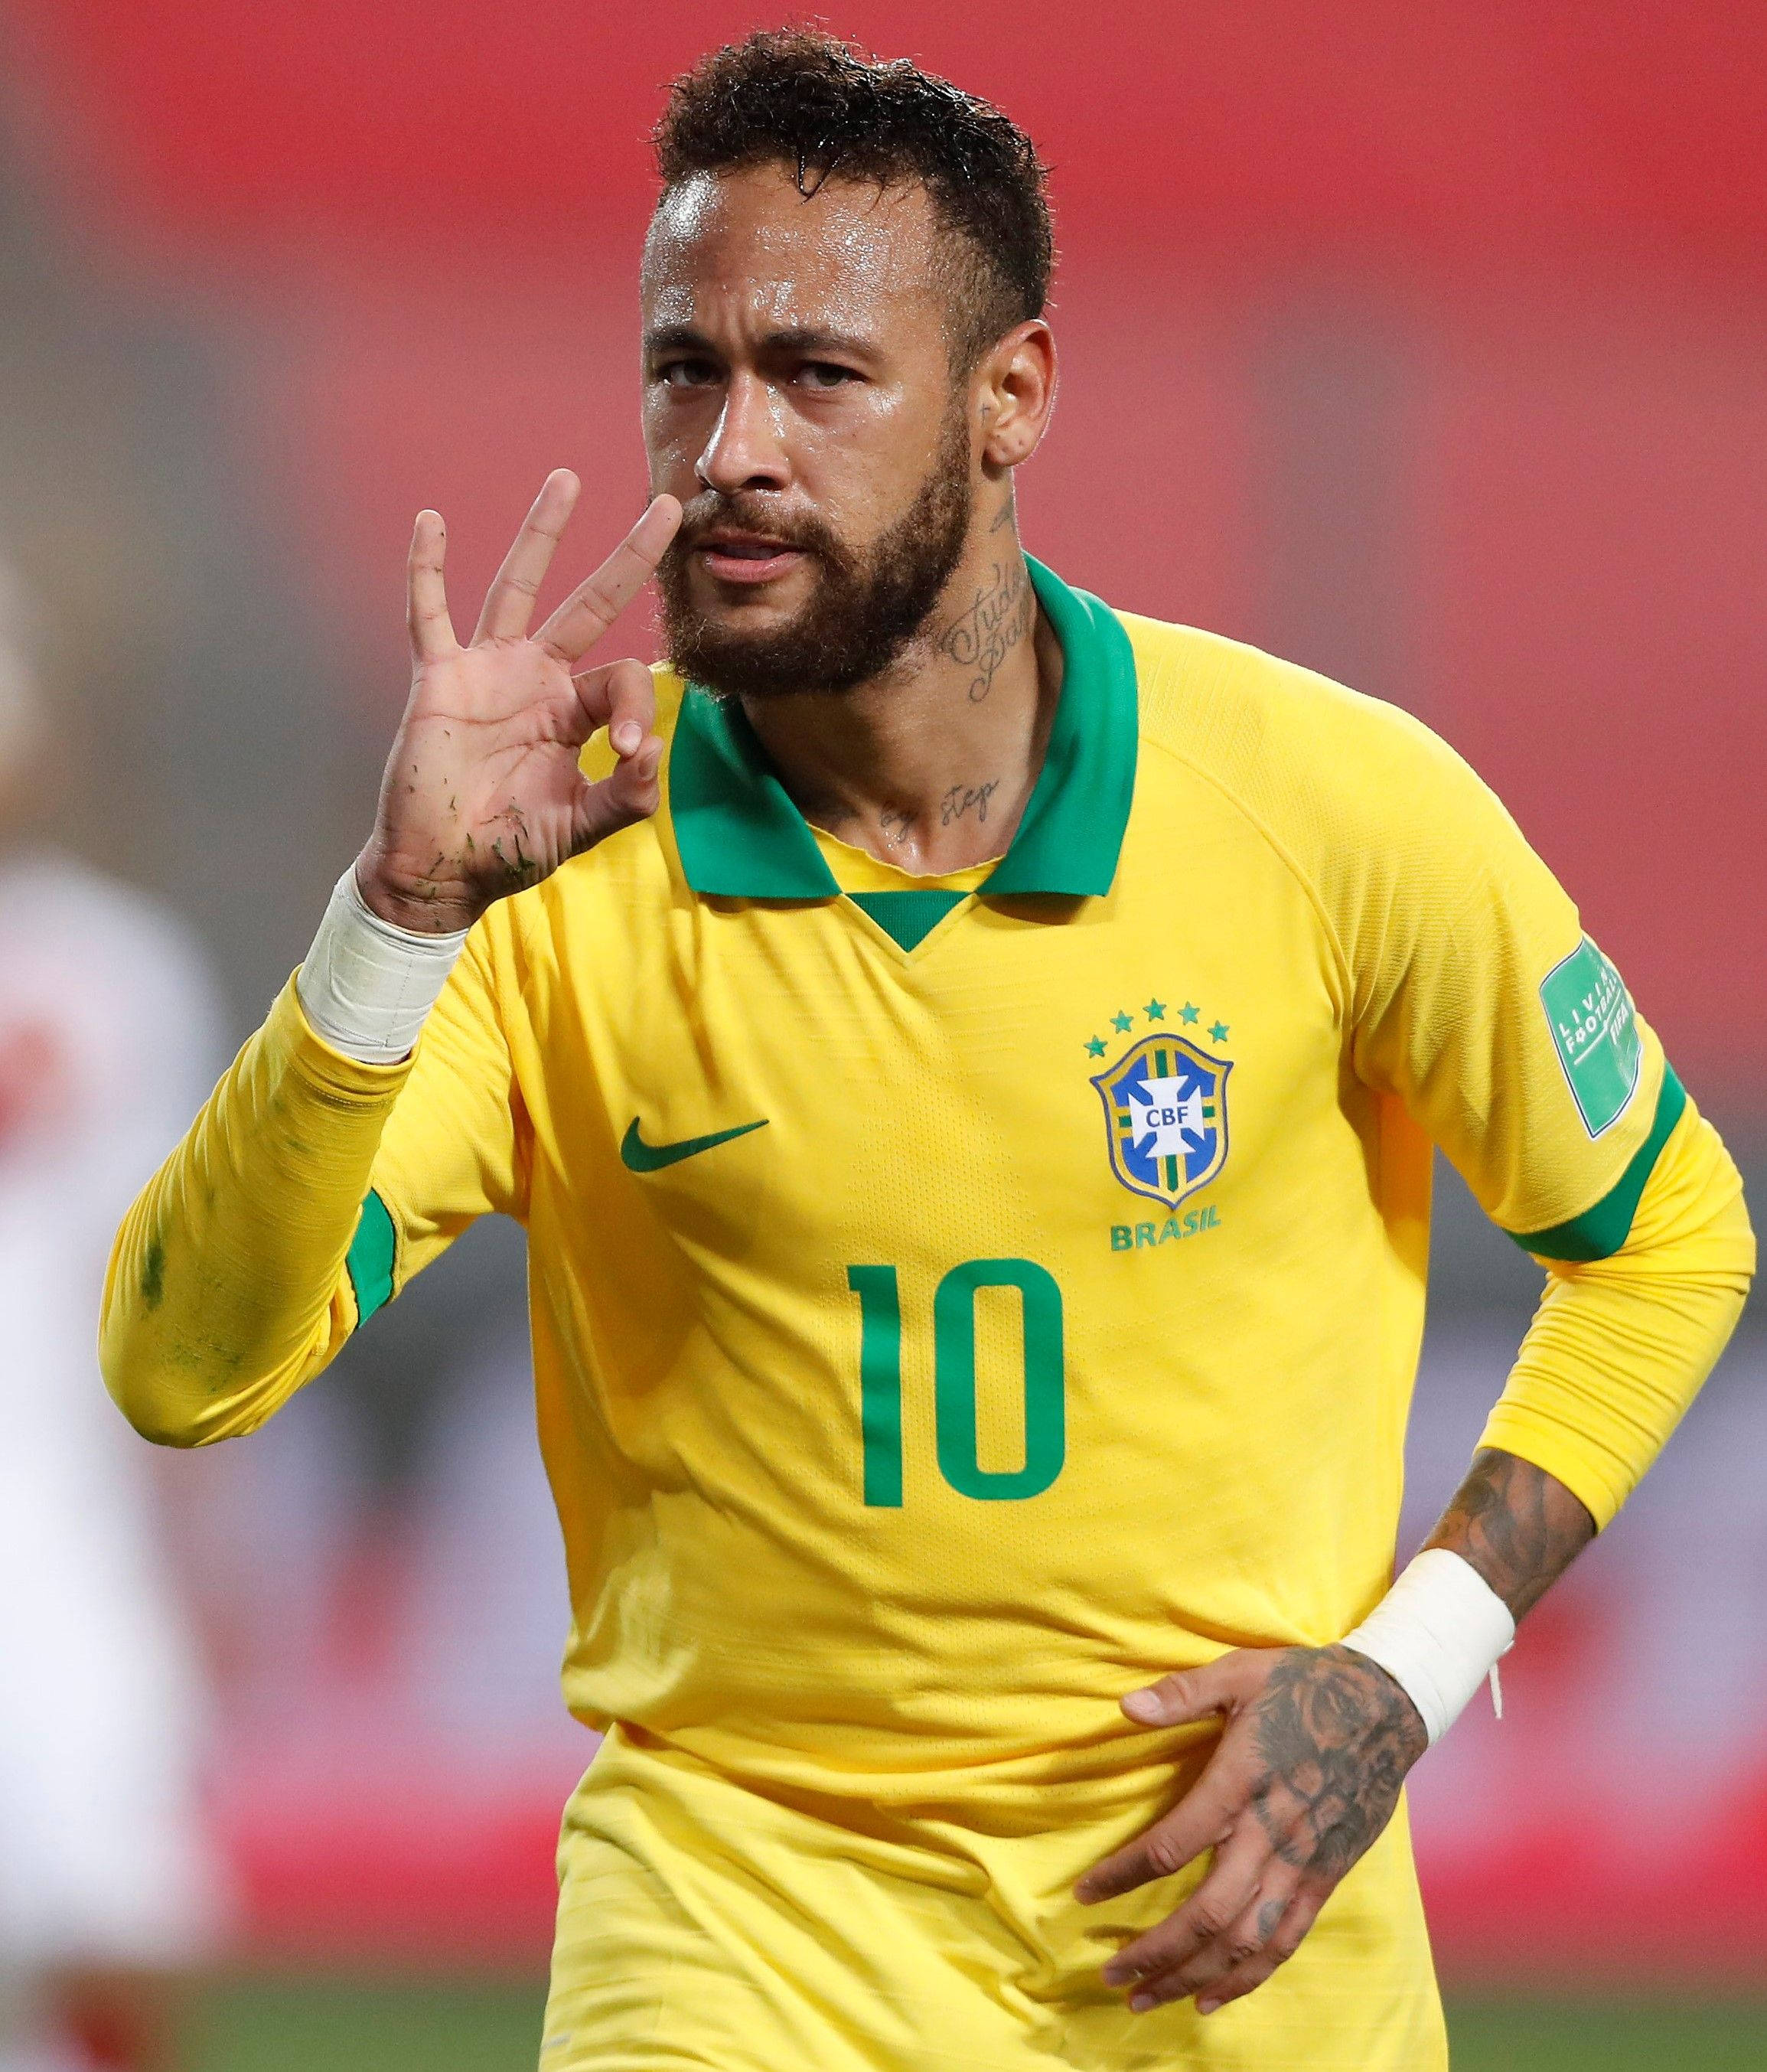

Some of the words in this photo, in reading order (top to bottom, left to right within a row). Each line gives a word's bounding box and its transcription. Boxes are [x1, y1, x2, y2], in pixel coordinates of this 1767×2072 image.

[1609, 1001, 1629, 1046] FIFA
[1146, 1105, 1188, 1127] CBF
[1110, 1205, 1222, 1251] BRASIL
[846, 1258, 1065, 1509] 10
